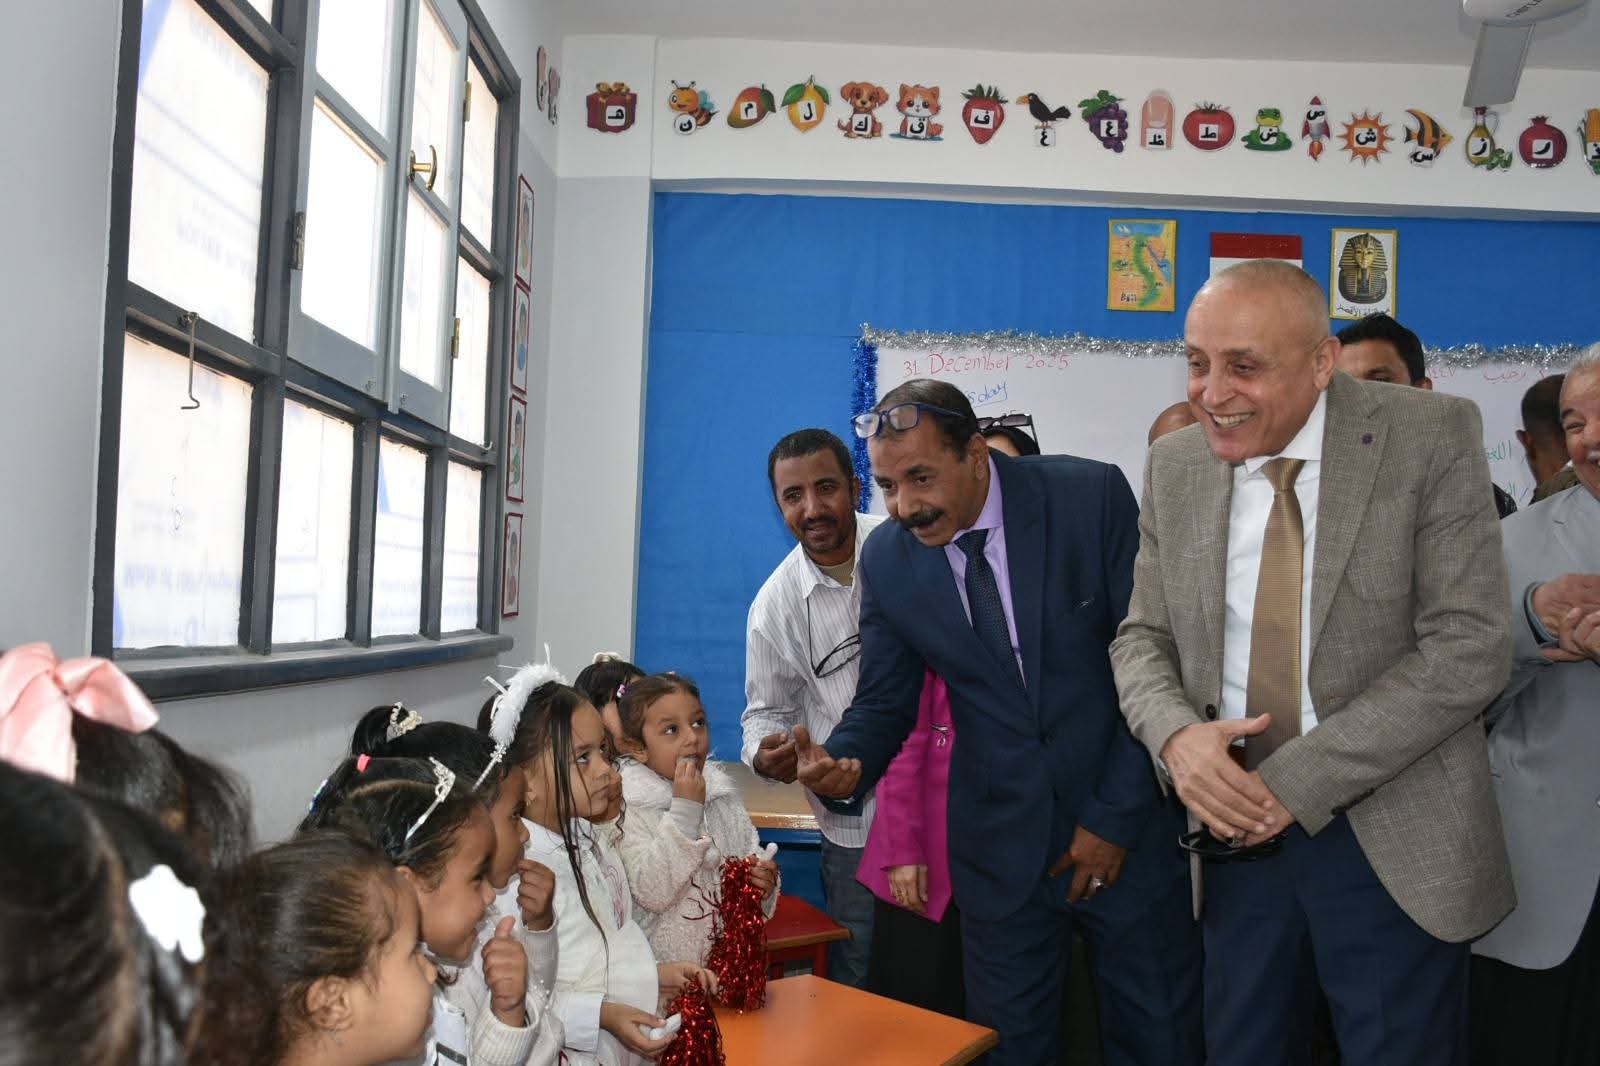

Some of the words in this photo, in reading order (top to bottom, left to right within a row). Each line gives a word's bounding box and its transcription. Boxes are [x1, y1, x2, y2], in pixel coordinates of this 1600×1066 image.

[744, 103, 754, 117] م
[804, 103, 812, 120] ل
[974, 110, 991, 124] ف
[680, 120, 692, 131] ن
[855, 117, 868, 132] ك
[909, 118, 924, 133] ق
[1201, 127, 1216, 138] ط
[1260, 128, 1278, 143] ض
[1356, 129, 1376, 145] ش
[1149, 135, 1164, 145] ظ
[1473, 138, 1487, 155] ز
[1535, 142, 1550, 154] ر
[1413, 152, 1434, 163] س
[904, 360, 921, 376] 31
[929, 352, 1016, 375] December
